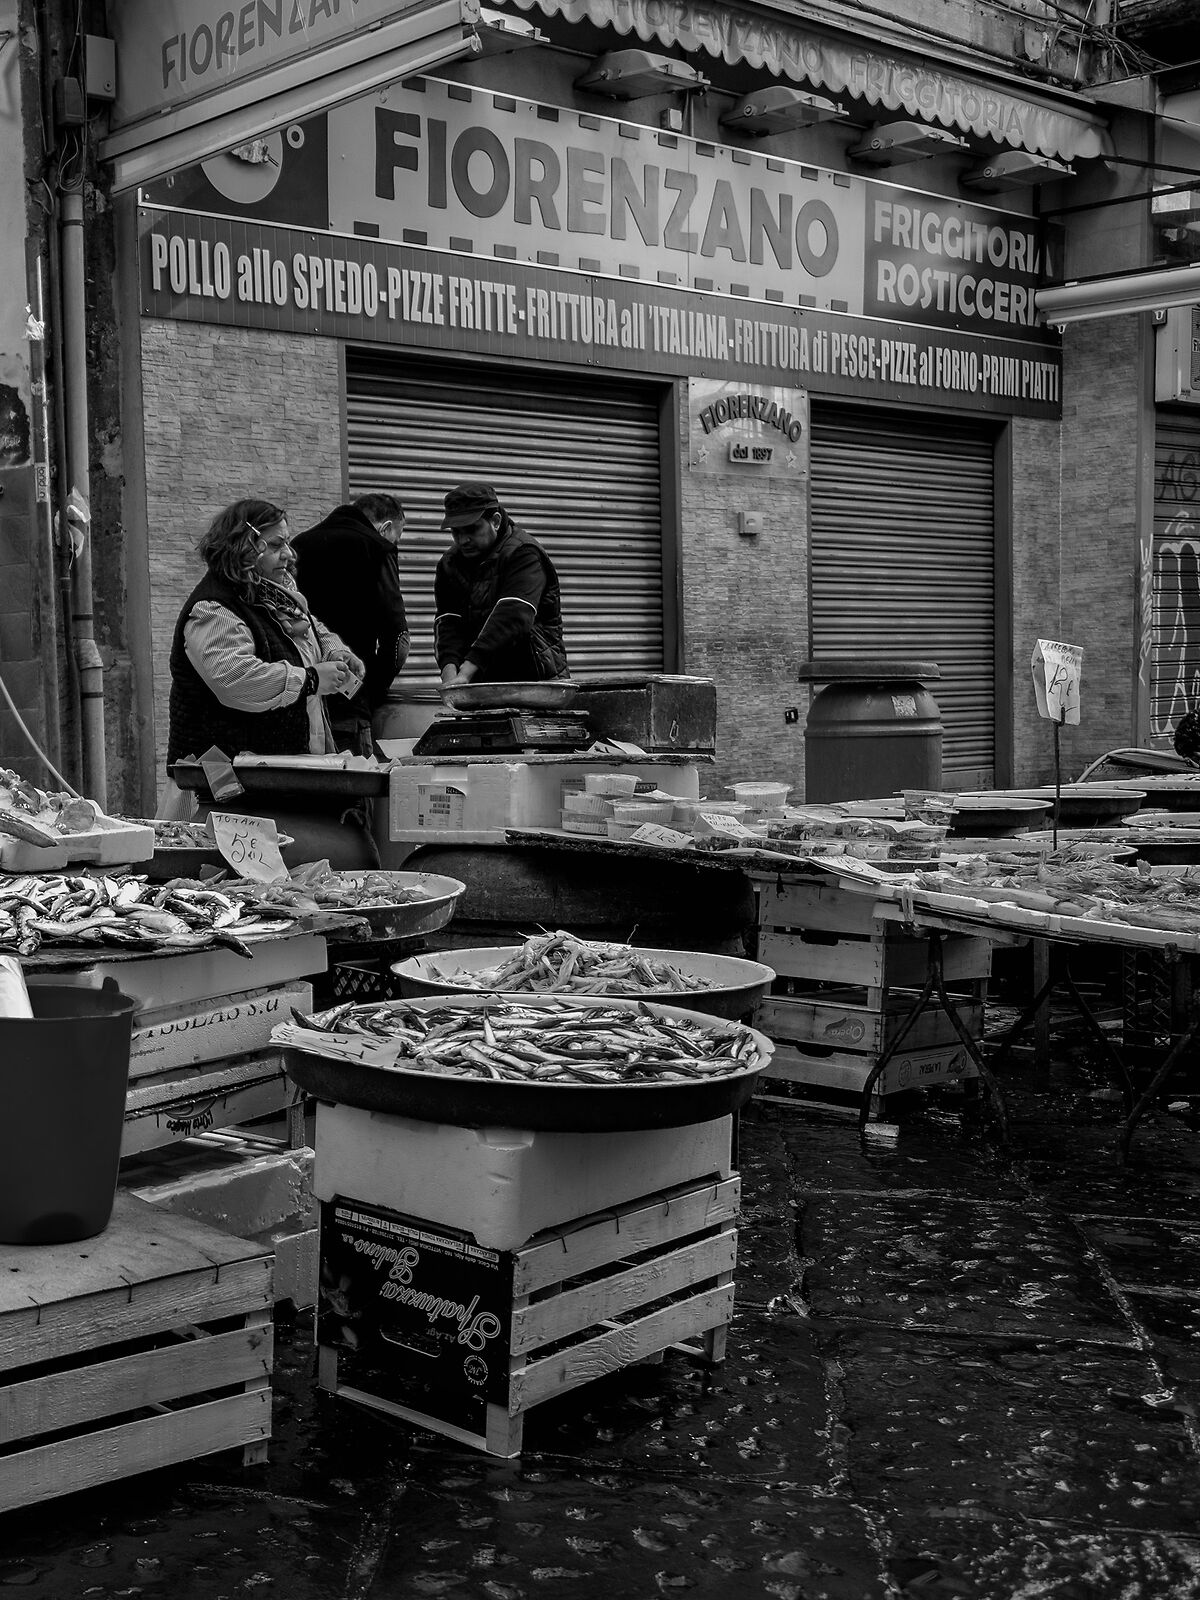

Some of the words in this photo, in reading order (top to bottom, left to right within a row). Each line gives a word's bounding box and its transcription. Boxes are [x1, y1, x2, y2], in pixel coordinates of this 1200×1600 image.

[850, 54, 1024, 135] FRIGGITORIA
[374, 106, 839, 278] FIORENZANO
[877, 259, 1041, 328] ROSTICCERI
[151, 233, 230, 299] POLLO
[237, 248, 287, 306] allo
[812, 329, 828, 374] di
[919, 349, 933, 387] al
[1022, 360, 1059, 402] PIATTI
[700, 395, 802, 442] FIORENZANO
[752, 447, 773, 460] 1897
[216, 815, 261, 827] TOTANI
[231, 832, 249, 863] 5
[829, 1025, 862, 1041] Opera
[353, 1240, 420, 1285] Gulino
